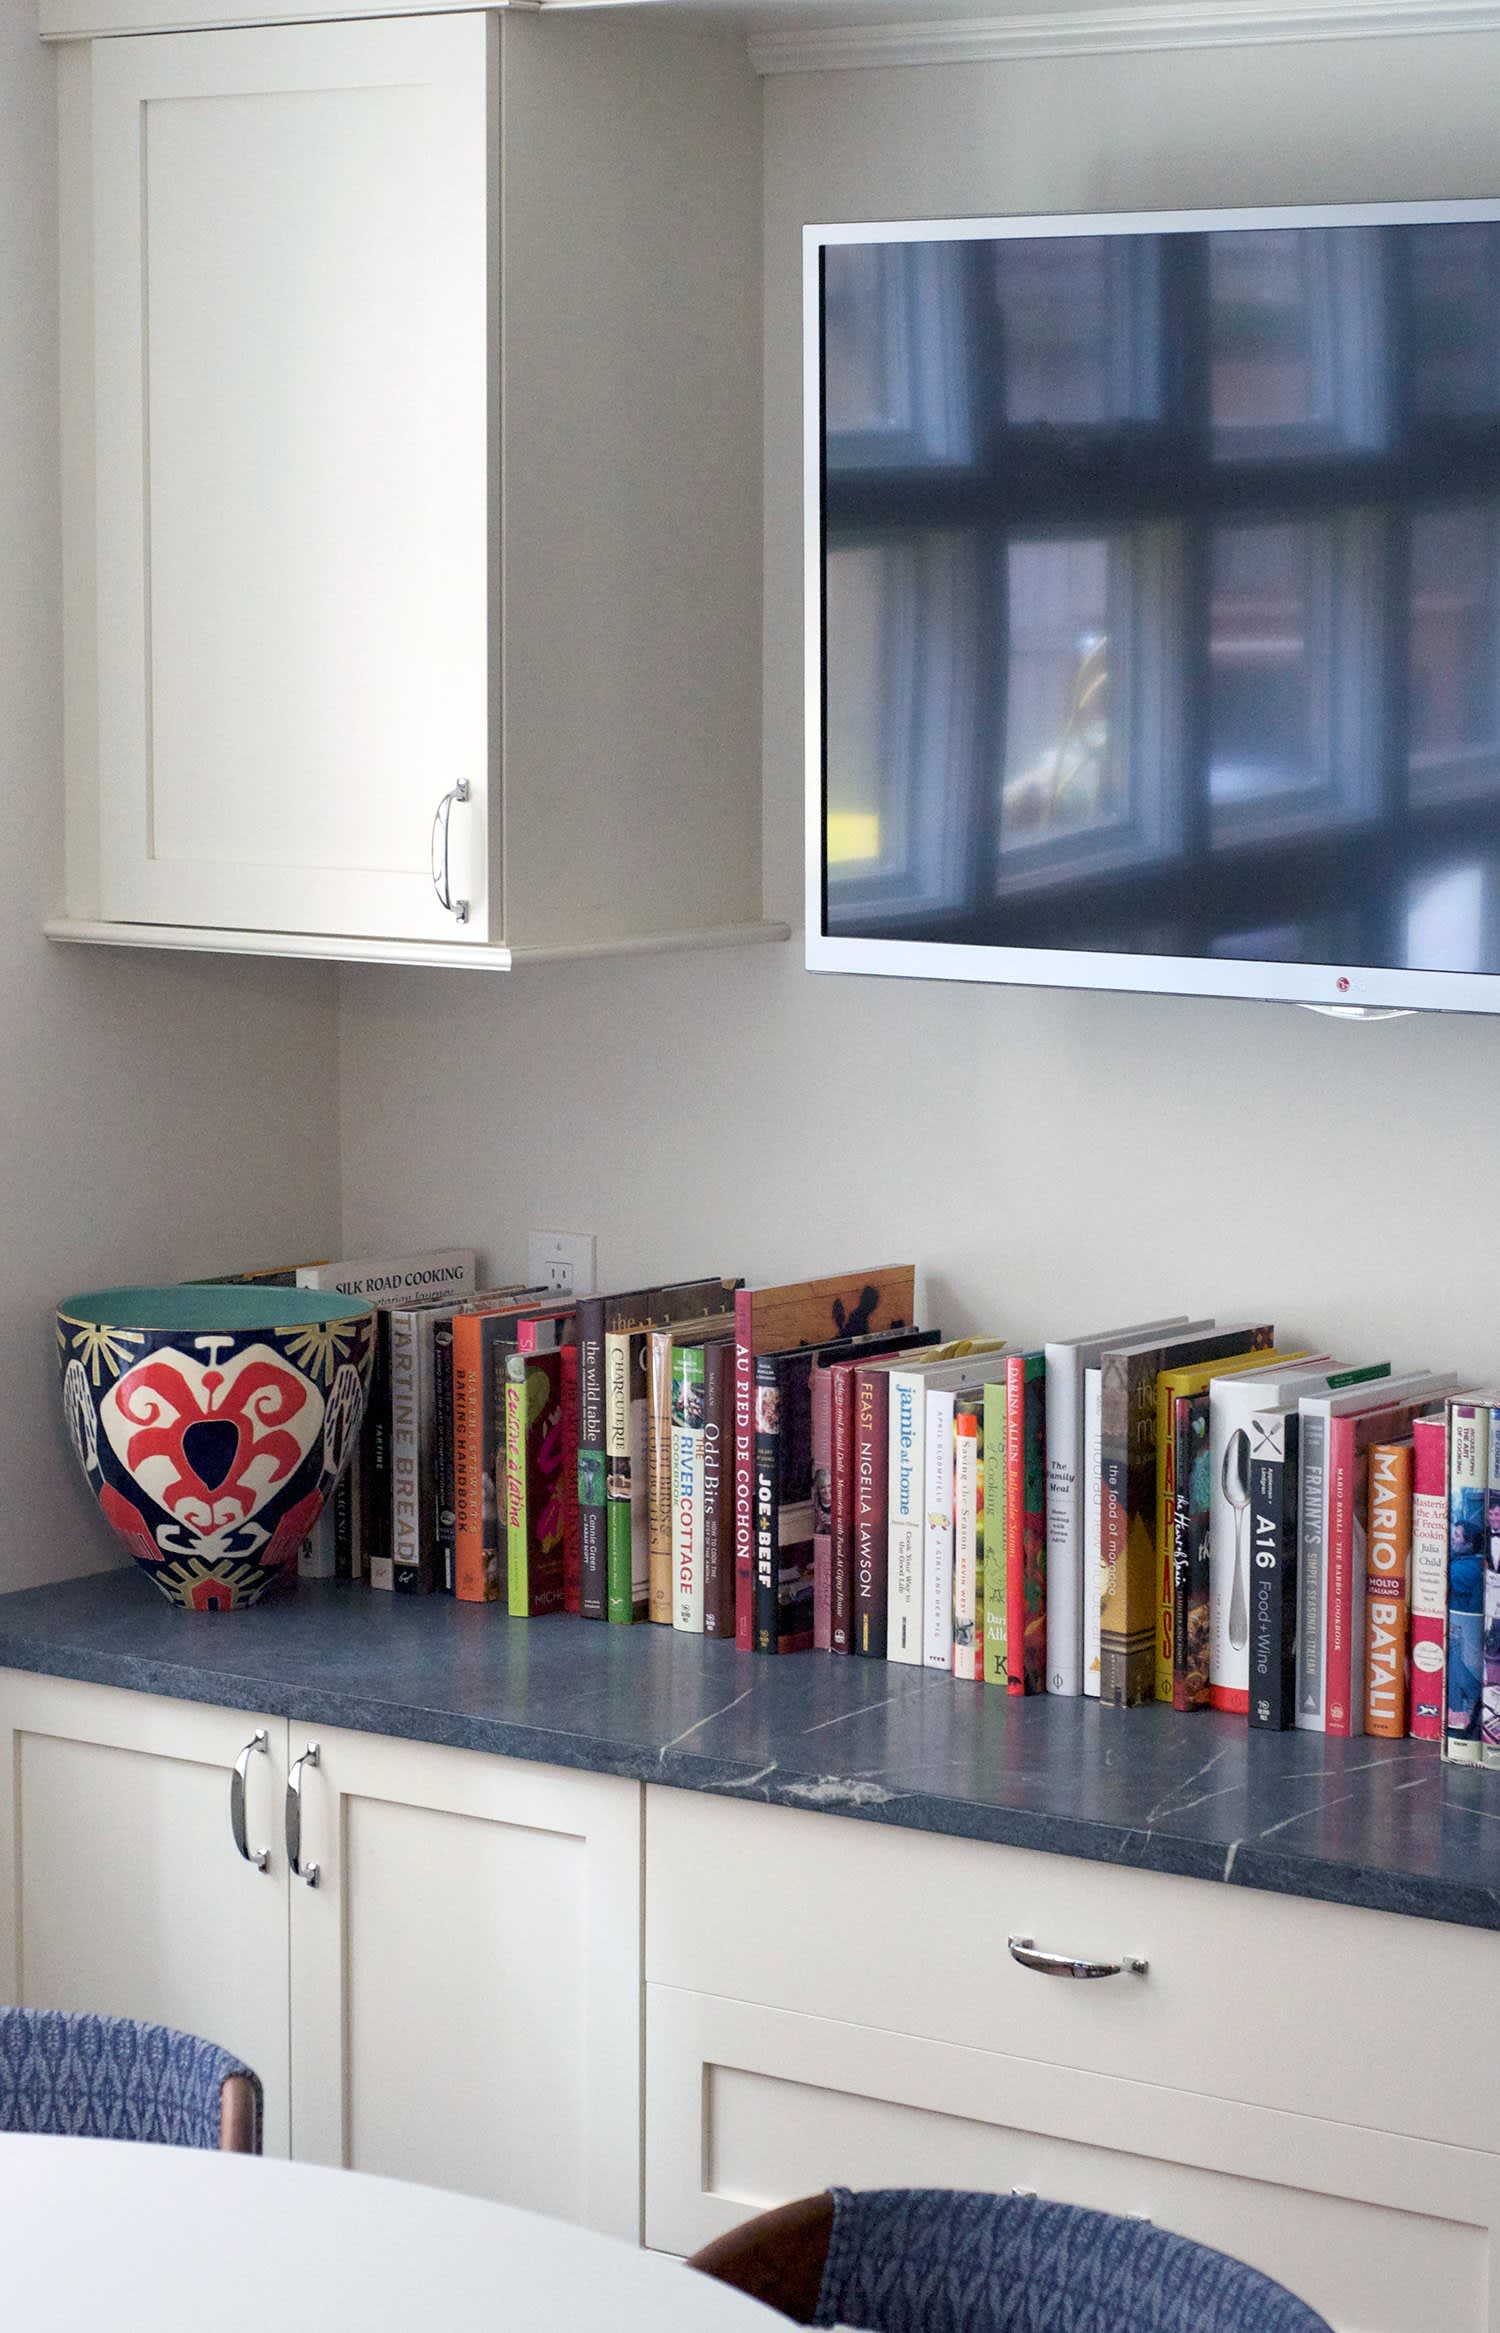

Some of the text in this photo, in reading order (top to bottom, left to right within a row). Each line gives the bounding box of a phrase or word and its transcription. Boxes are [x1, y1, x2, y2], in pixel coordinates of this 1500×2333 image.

[335, 1265, 464, 1296] SILK ROAD COOKING
[612, 1312, 636, 1329] the
[394, 1313, 414, 1447] TARTINE
[586, 1340, 601, 1442] the wild table
[610, 1346, 627, 1450] CHARCUTERIE
[1009, 1366, 1019, 1420] DARINA
[860, 1382, 873, 1431] FEAST
[895, 1383, 916, 1449] jamie
[1456, 1426, 1463, 1436] OF
[375, 1423, 384, 1470] TARTINE
[456, 1369, 468, 1533] BAKING HANDBOOK
[468, 1370, 478, 1534] MARTHA STEWART'S
[696, 1438, 705, 1460] THE
[736, 1343, 750, 1559] AU PIED DE COCHON
[900, 1450, 909, 1465] at
[935, 1410, 944, 1503] APRIL BLOOMFIELD
[1009, 1421, 1019, 1463] ALLEN
[1051, 1461, 1067, 1470] The
[704, 1423, 720, 1514] Odd Bits
[860, 1442, 873, 1514] NIGELLA
[899, 1465, 913, 1516] home
[986, 1456, 999, 1516] Cooking
[1336, 1468, 1344, 1498] MARIO
[394, 1457, 416, 1561] BREAD
[758, 1472, 773, 1516] JOE
[959, 1440, 969, 1551] Saving the Season
[1372, 1452, 1398, 1570] MARIO
[1415, 1497, 1448, 1508] asterin
[1416, 1509, 1430, 1518] the
[589, 1514, 597, 1572] Connie Green
[836, 1536, 844, 1557] Food
[1107, 1464, 1119, 1597] the food of morocco
[1173, 1493, 1192, 1588] the Heart of Spain
[1413, 1528, 1444, 1540] Cookin
[1420, 1543, 1440, 1553] Julia
[1423, 1519, 1447, 1530] Frenc
[758, 1531, 773, 1589] BEEF
[860, 1522, 872, 1598] LAWSON
[898, 1555, 906, 1577] Good
[905, 1553, 913, 1573] Your
[1304, 1465, 1322, 1675] FRANNY'S SIMPLE SEASONAL ITALIAN
[1335, 1542, 1343, 1560] THE
[1418, 1556, 1442, 1567] Child
[898, 1577, 906, 1594] Life
[904, 1575, 913, 1593] Way
[1255, 1514, 1277, 1674] A16 Food+Wine
[1335, 1563, 1343, 1596] BABBO
[1369, 1578, 1400, 1589] MOLTO
[986, 1612, 1007, 1625] Dari
[1334, 1597, 1342, 1651] COOKBOOK
[1369, 1602, 1398, 1719] BATALI
